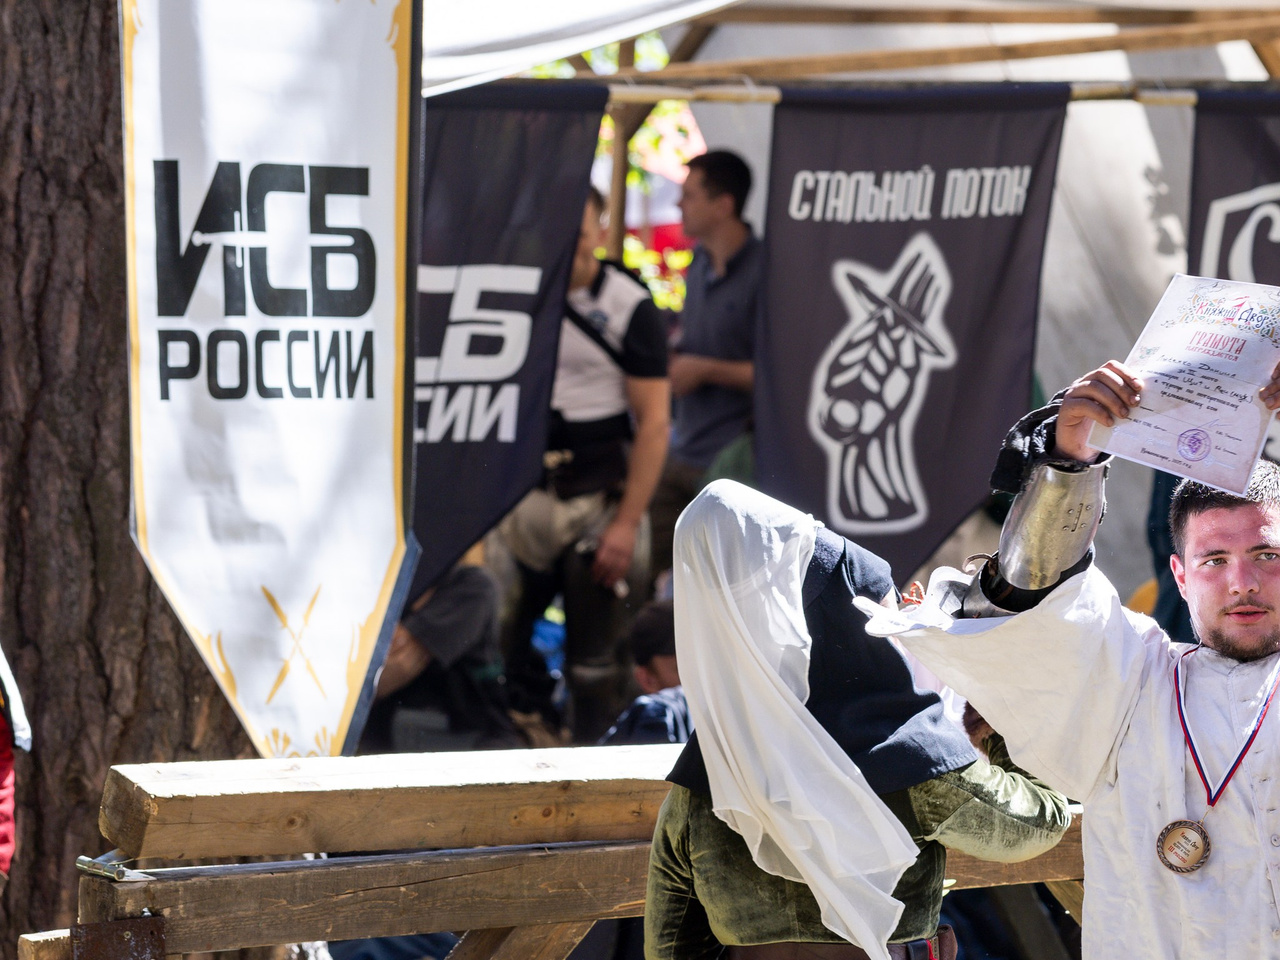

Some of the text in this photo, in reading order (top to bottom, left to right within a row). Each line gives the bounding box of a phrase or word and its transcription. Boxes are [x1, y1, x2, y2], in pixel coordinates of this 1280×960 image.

[788, 165, 1032, 223] СТАЛЬНОЙ ПОТОК
[153, 160, 376, 318] ИСБ
[415, 264, 543, 384] СБ
[1189, 330, 1247, 355] ГРАМОТА
[158, 329, 375, 400] РОССИИ
